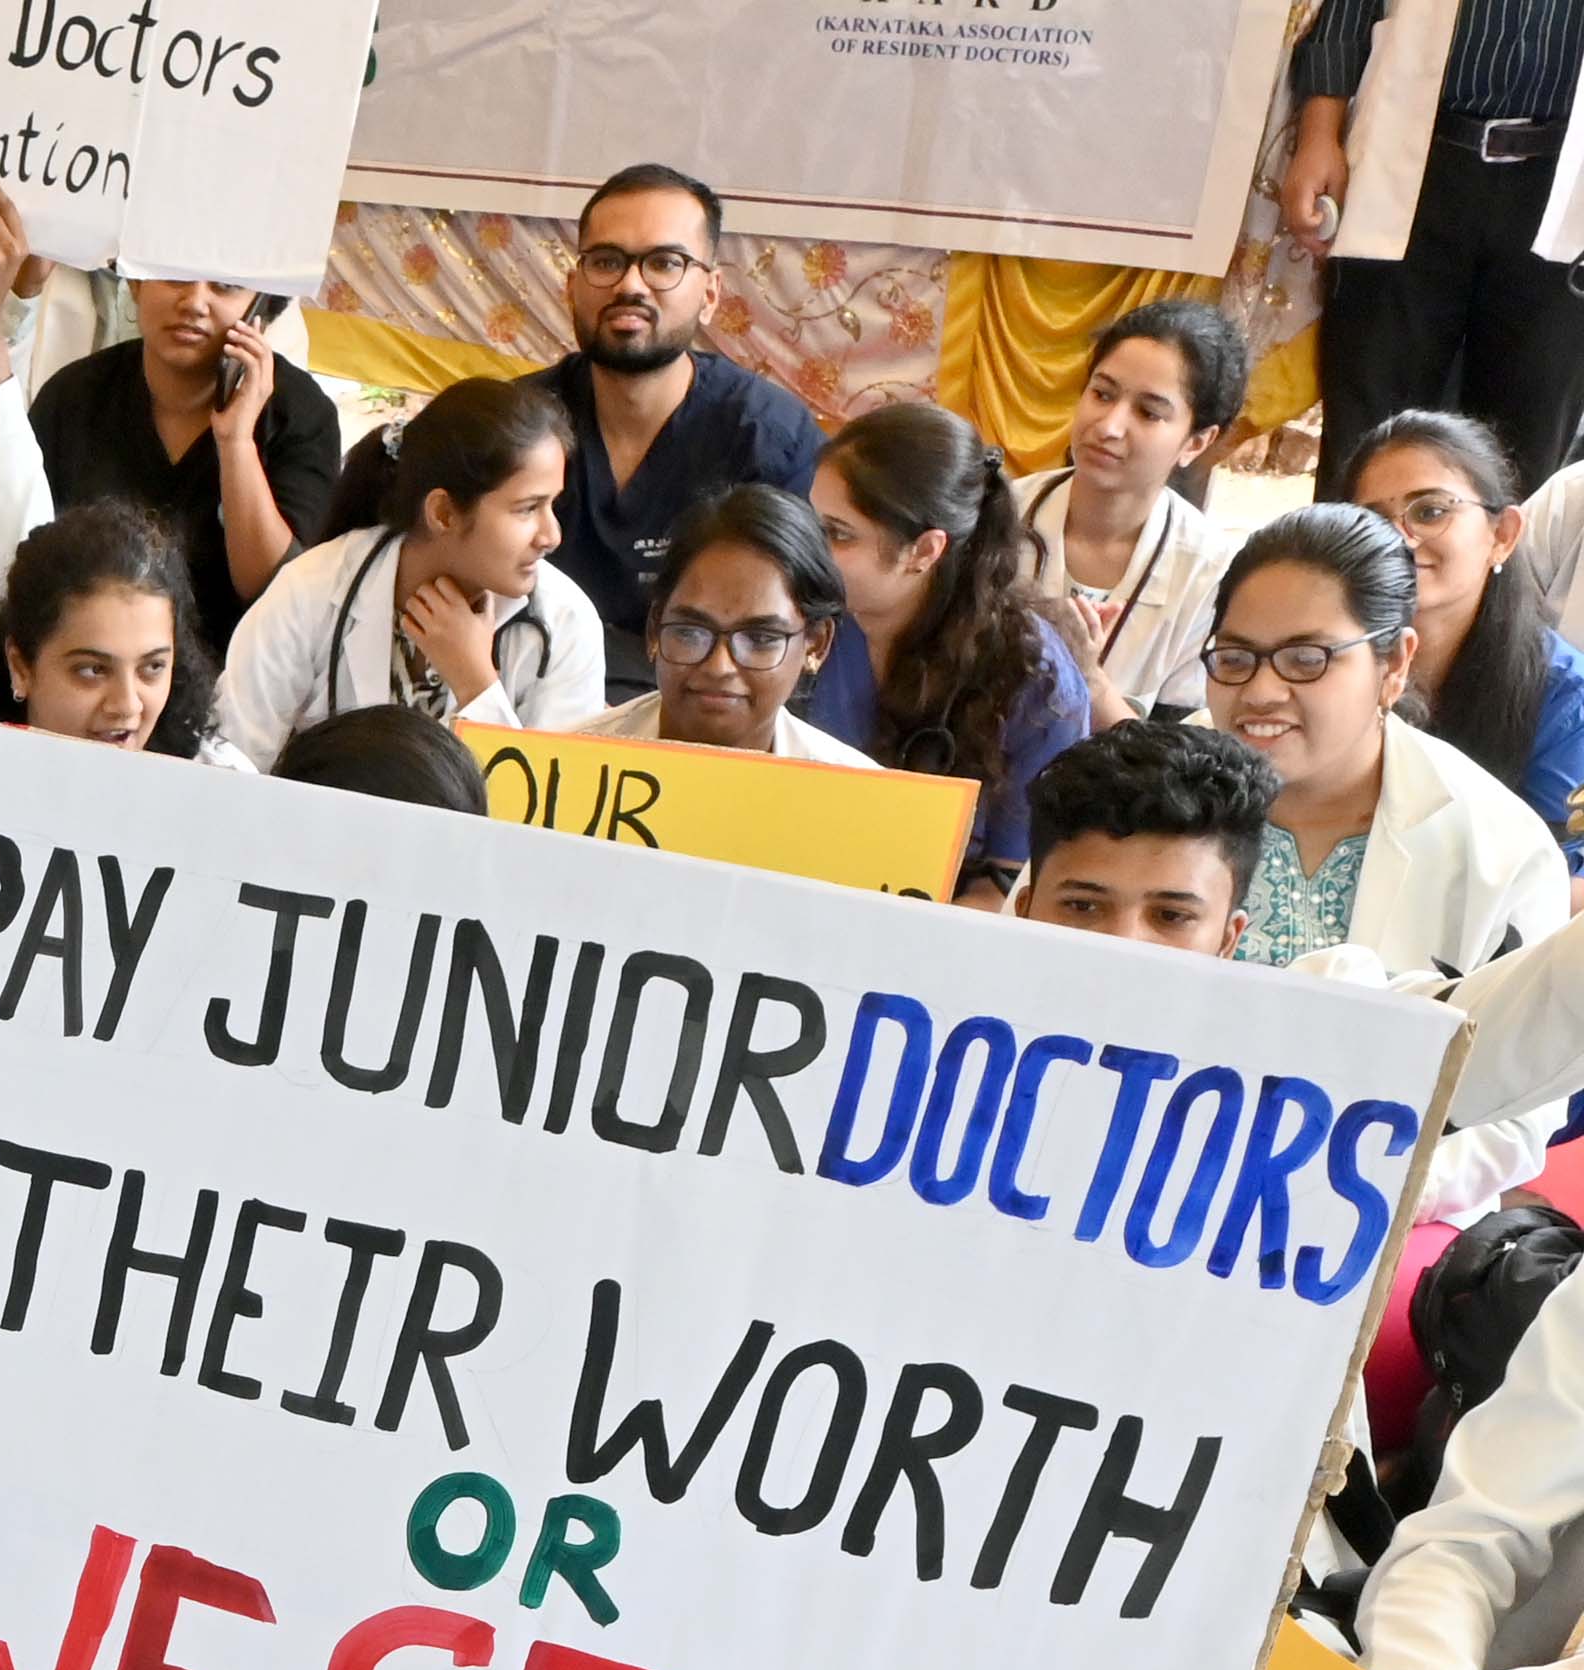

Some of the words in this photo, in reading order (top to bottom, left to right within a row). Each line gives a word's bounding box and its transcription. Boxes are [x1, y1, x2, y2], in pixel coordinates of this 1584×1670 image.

[815, 14, 945, 39] (KARNATAKA
[952, 22, 1094, 46] ASSOCIATION
[830, 37, 859, 56] OF
[862, 39, 961, 63] RESIDENT
[965, 45, 1072, 69] DOCTORS)
[202, 881, 828, 1178] JUNIOR
[817, 992, 1421, 1305] DOCTORS
[567, 1279, 1223, 1622] WORTH
[404, 1470, 622, 1626] OR
